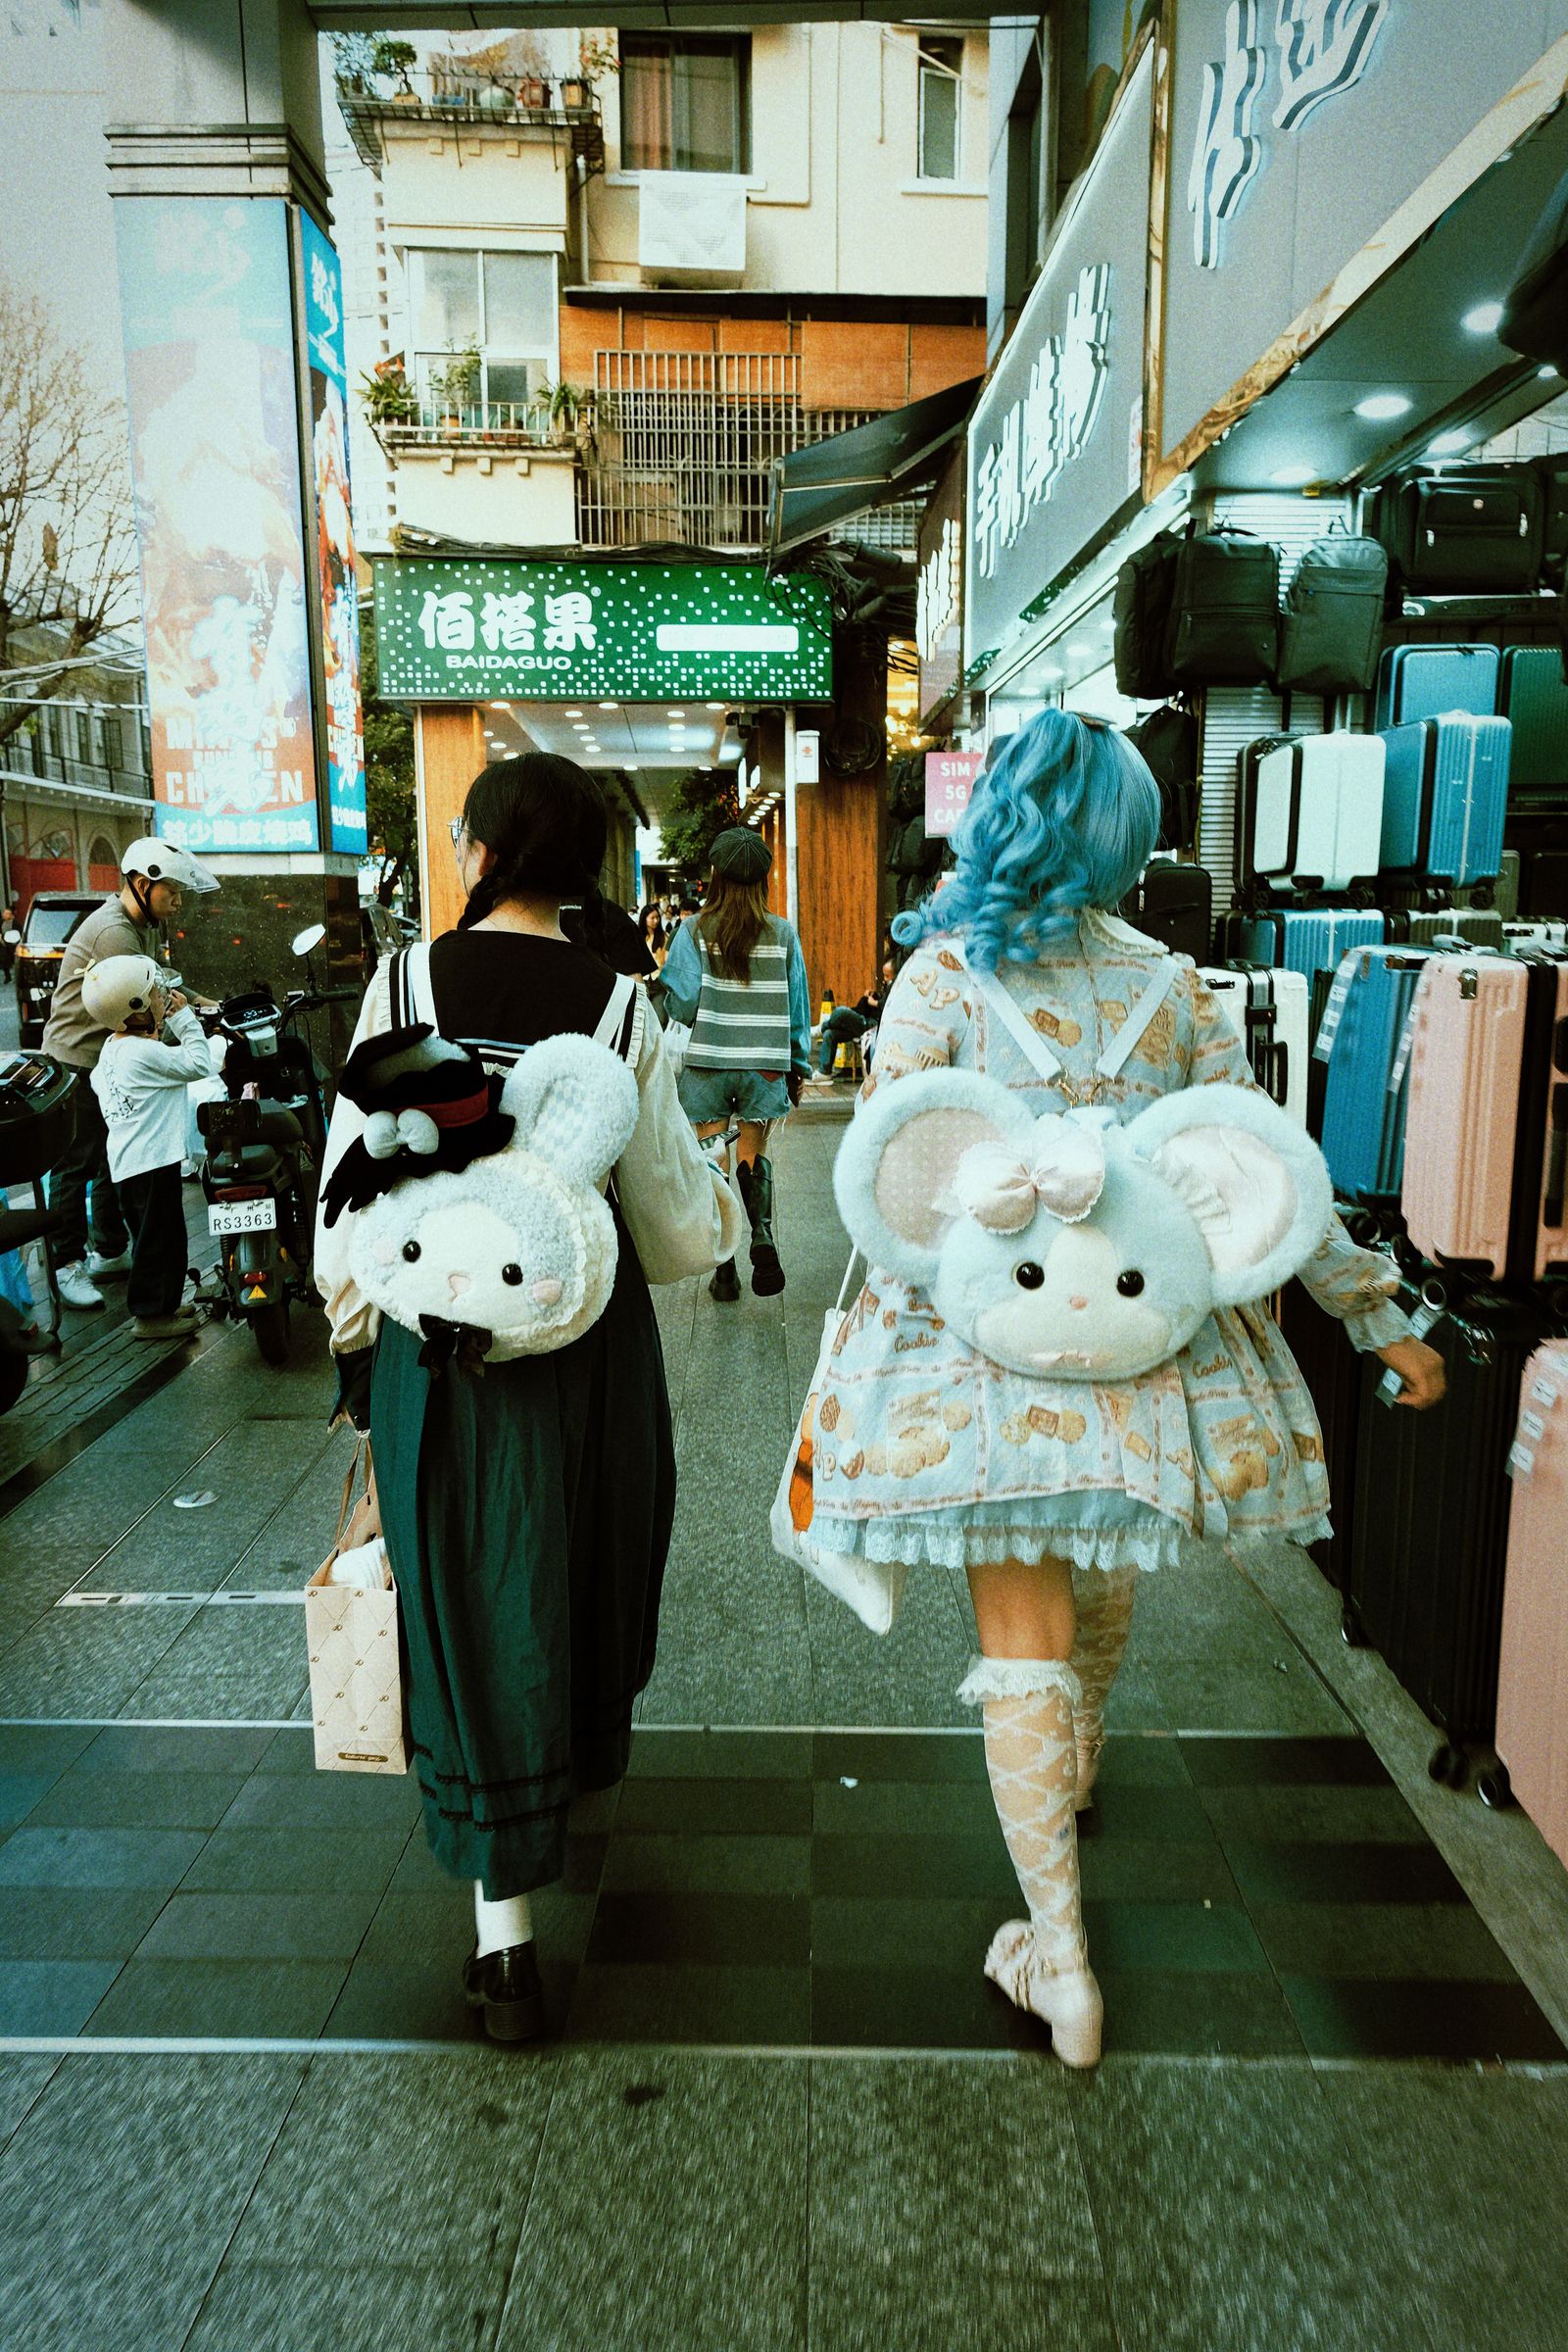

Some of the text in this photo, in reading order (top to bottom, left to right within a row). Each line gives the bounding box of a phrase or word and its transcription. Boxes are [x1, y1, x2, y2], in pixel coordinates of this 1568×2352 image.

[446, 655, 572, 670] BAIDAGUO
[941, 761, 970, 777] SIM
[945, 784, 967, 800] 5G
[213, 1212, 272, 1231] RS3363
